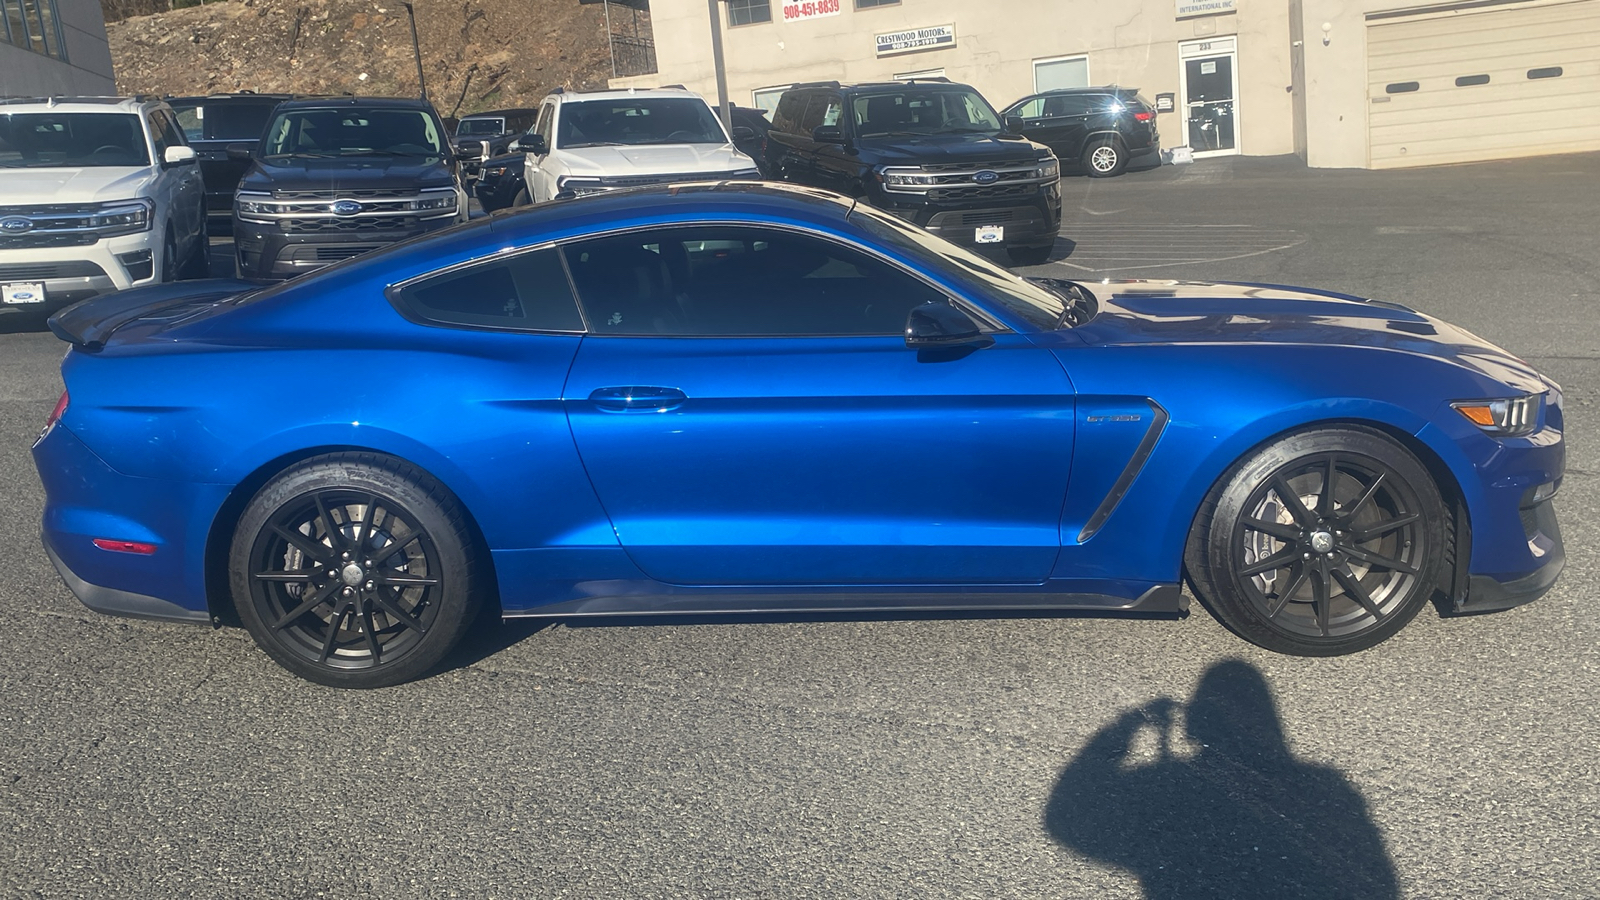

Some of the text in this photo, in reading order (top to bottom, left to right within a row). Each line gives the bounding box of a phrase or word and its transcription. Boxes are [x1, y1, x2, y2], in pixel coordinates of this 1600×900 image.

[784, 0, 839, 19] 908-451-8839
[1179, 3, 1221, 13] INTERNATIONAL
[876, 32, 916, 44] CRESTWOOD
